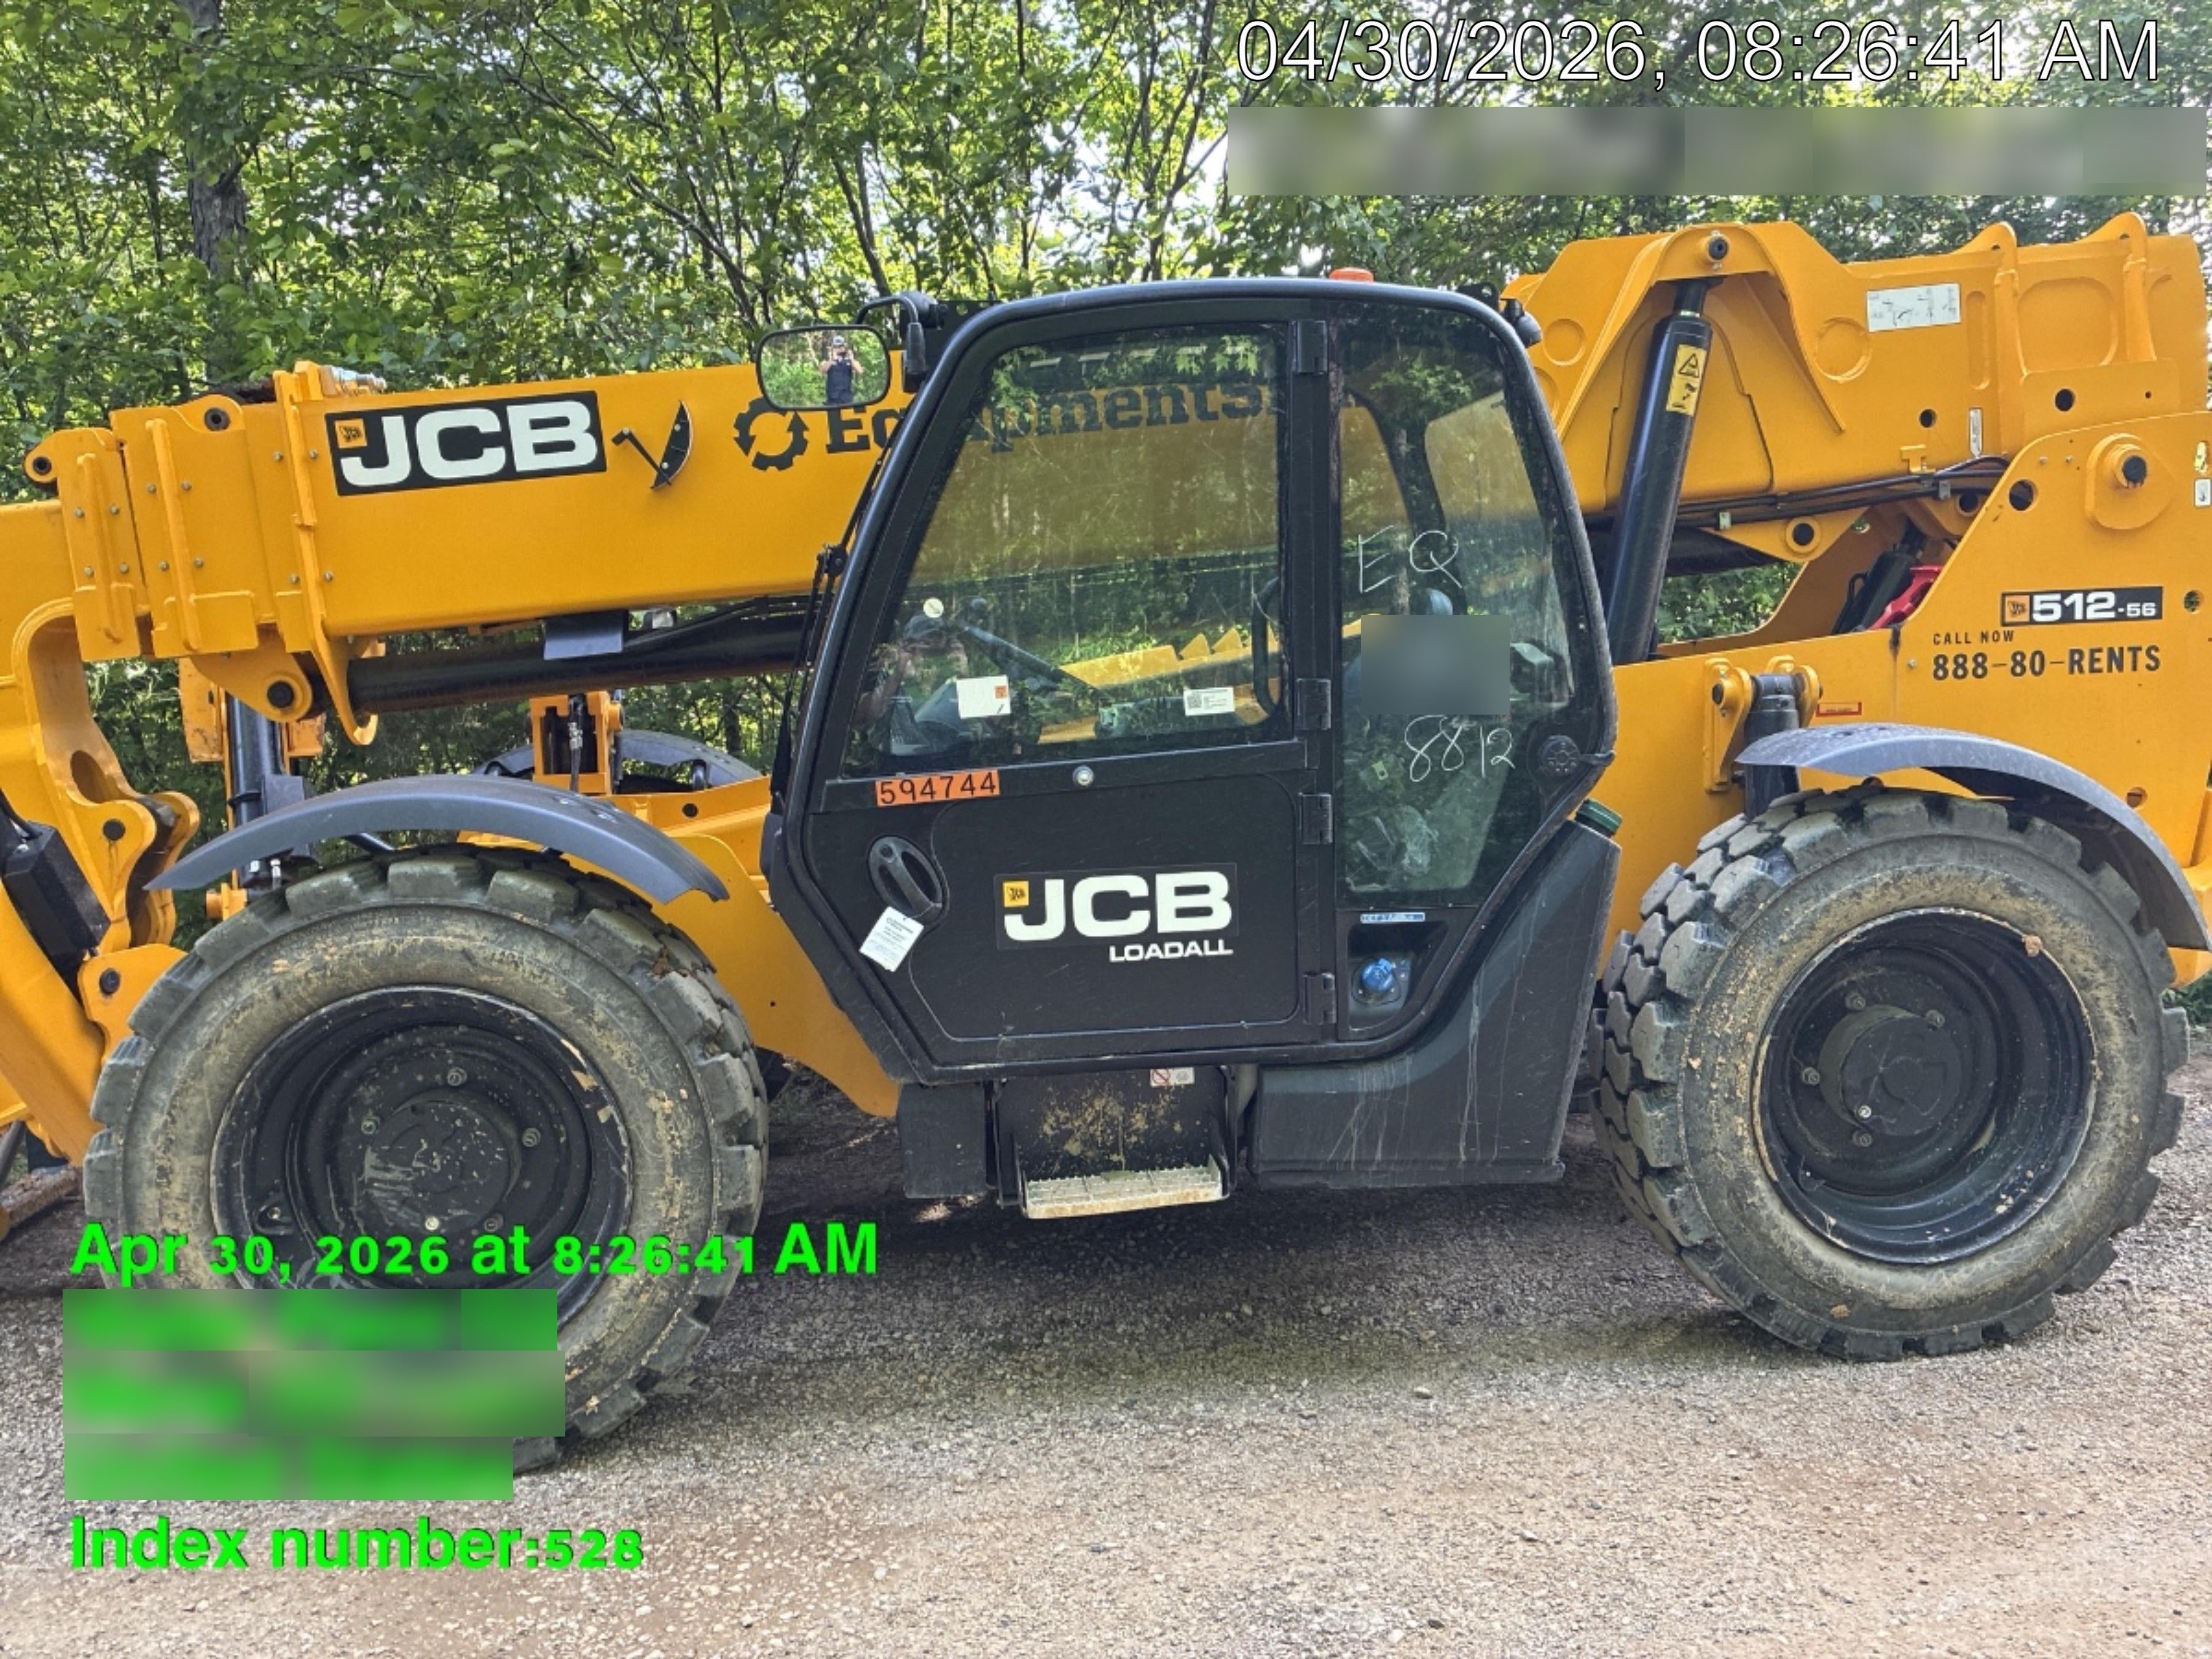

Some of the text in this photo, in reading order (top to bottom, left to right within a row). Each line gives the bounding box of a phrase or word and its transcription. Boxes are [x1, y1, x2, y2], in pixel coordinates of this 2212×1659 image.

[340, 401, 598, 486] JCB
[1358, 525, 1462, 594] EQ
[2032, 590, 2157, 622] 512-56
[1933, 629, 2015, 645] CALL NOW
[1932, 645, 2162, 681] 888-80-RENTS
[880, 771, 997, 804] 594744
[1004, 871, 1233, 942] JCB
[1109, 939, 1234, 963] LOADALL
